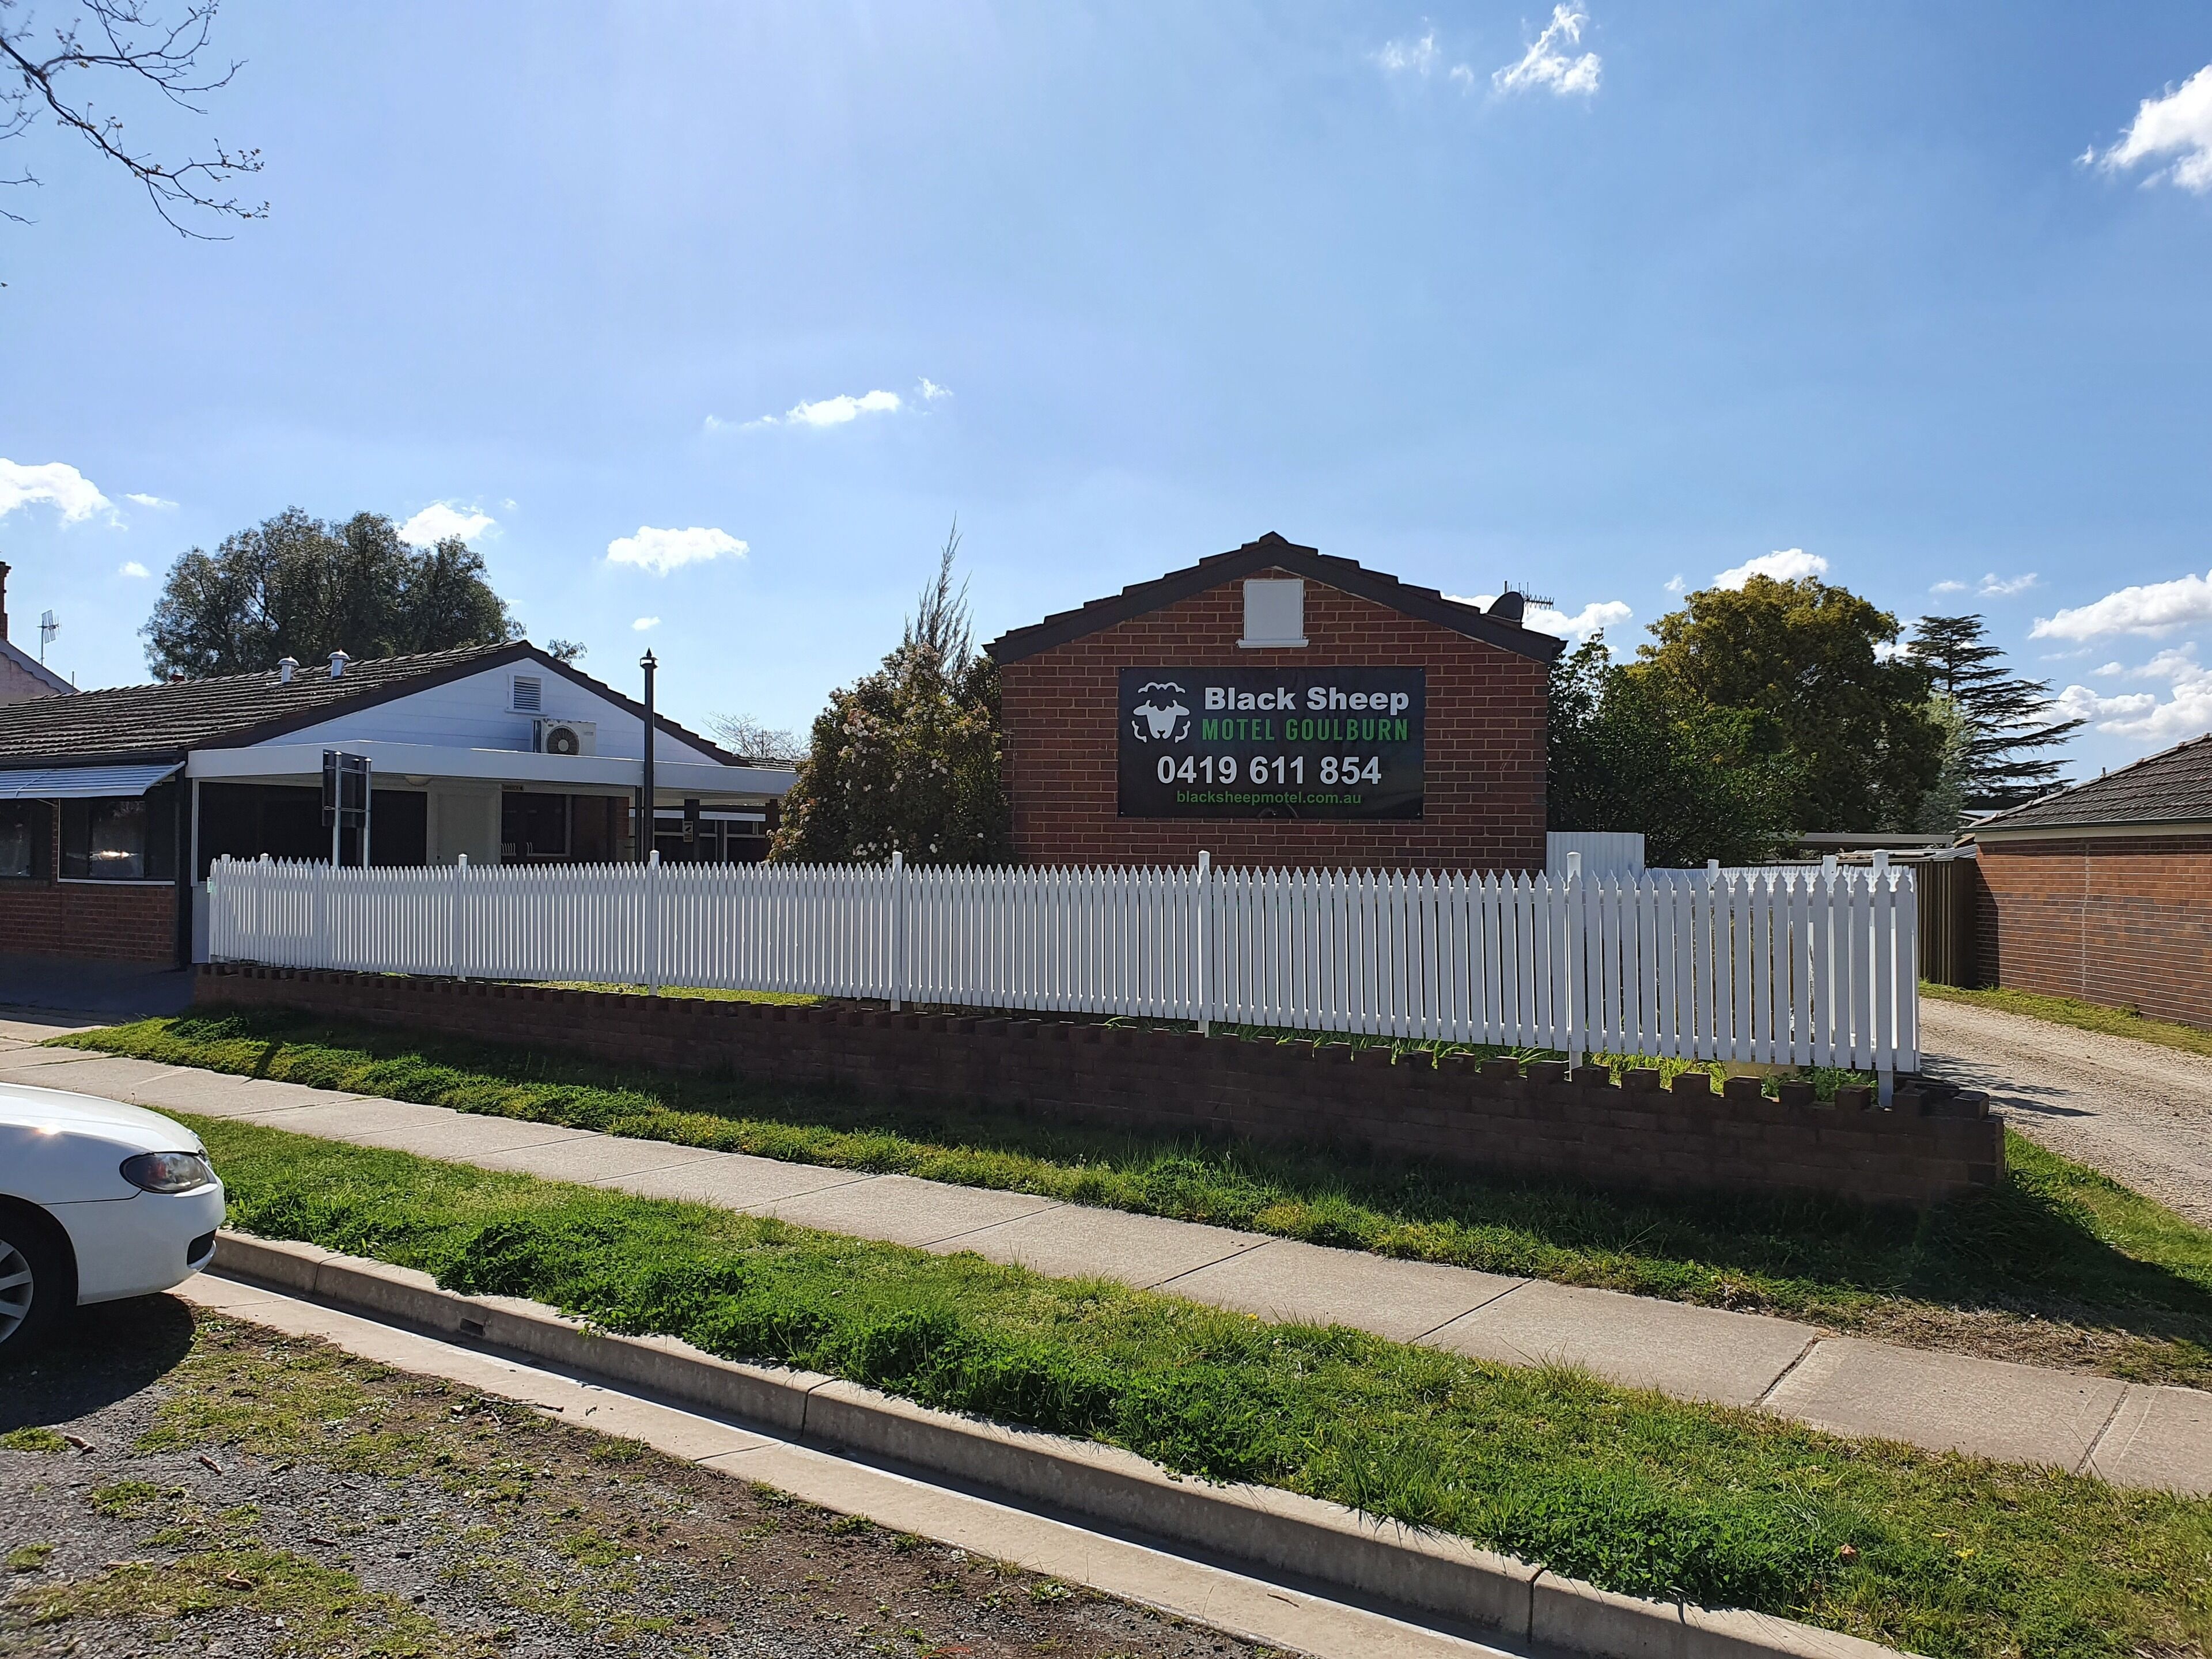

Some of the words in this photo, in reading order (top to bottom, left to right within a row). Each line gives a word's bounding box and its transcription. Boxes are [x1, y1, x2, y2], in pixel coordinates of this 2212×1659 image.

[1205, 687, 1296, 710] Black
[1306, 686, 1410, 716] Sheep
[1202, 718, 1275, 741] MOTEL
[1285, 718, 1408, 741] GOULBURN
[1157, 755, 1237, 784] 0419
[1249, 755, 1304, 784] 611
[1319, 756, 1382, 785] 854
[1176, 790, 1361, 805] blacksheepmotel.com.au
